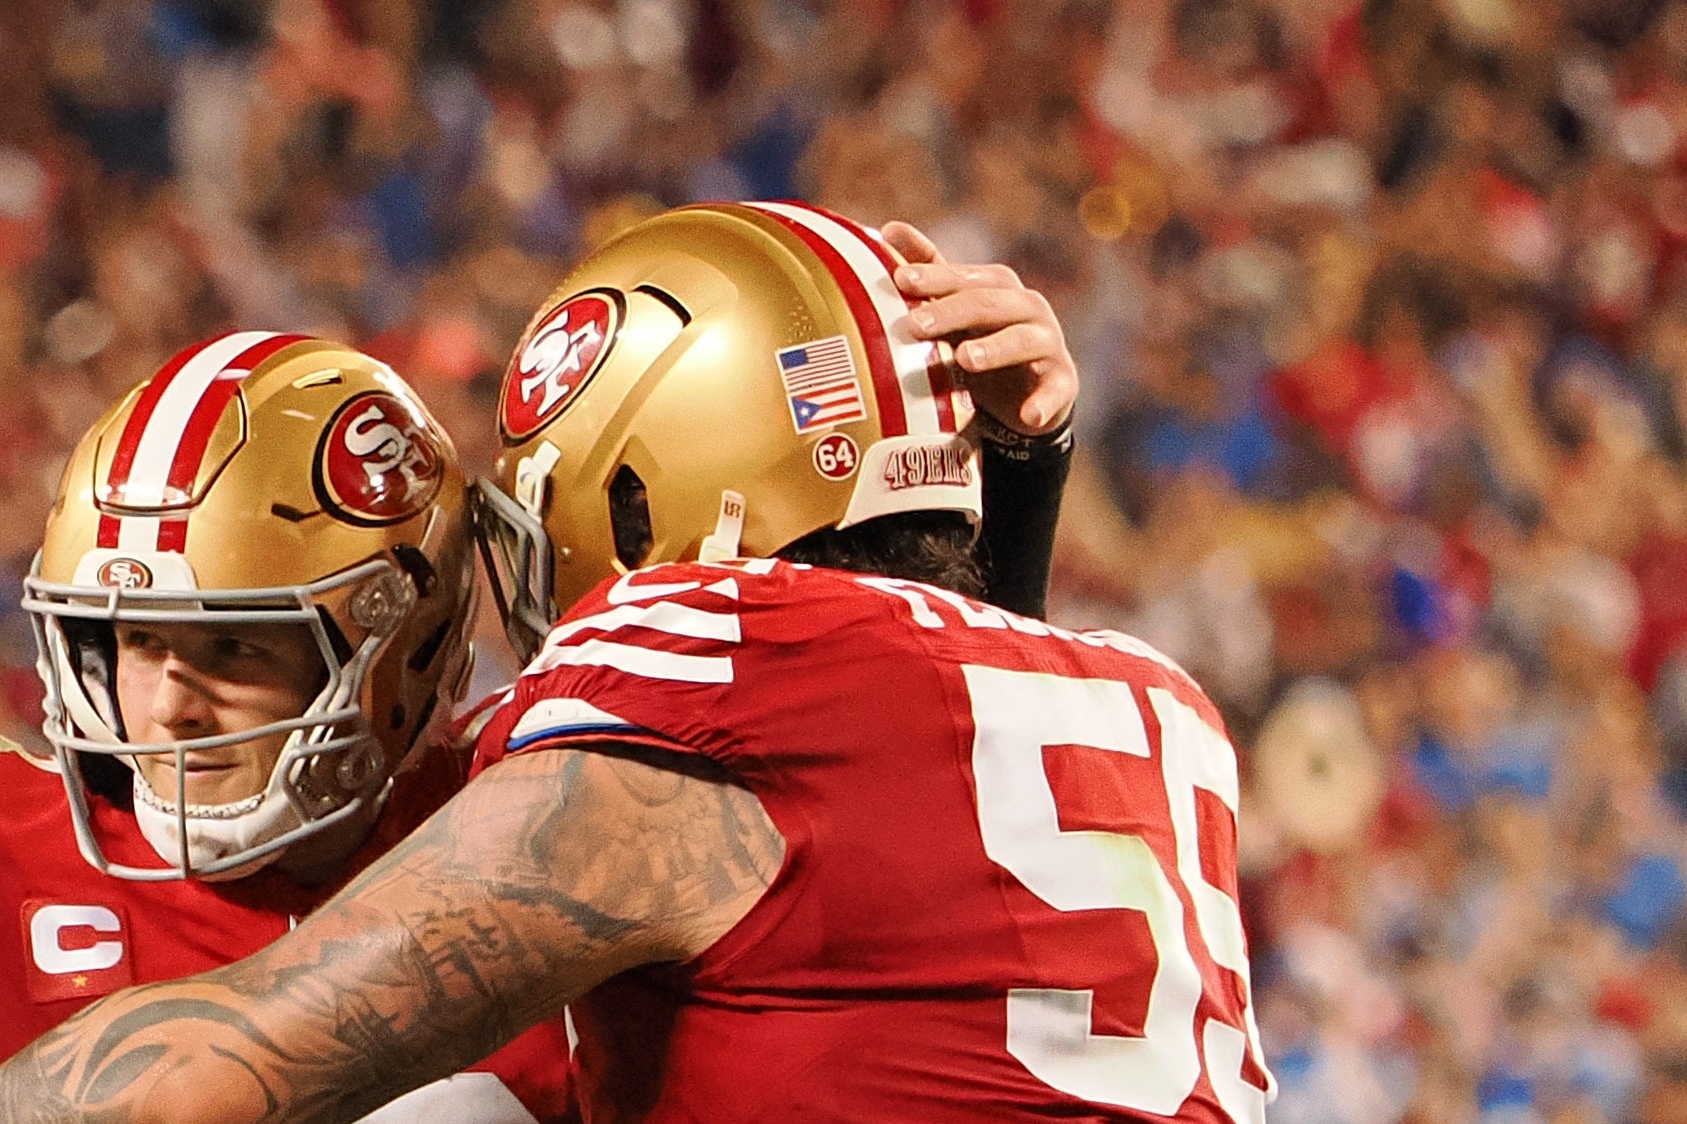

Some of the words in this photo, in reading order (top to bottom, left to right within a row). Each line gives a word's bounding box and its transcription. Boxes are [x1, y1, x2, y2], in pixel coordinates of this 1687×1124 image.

[520, 309, 601, 417] SF
[344, 404, 431, 503] SF
[818, 440, 855, 472] 64
[884, 444, 973, 491] 49ERS
[30, 905, 124, 974] C
